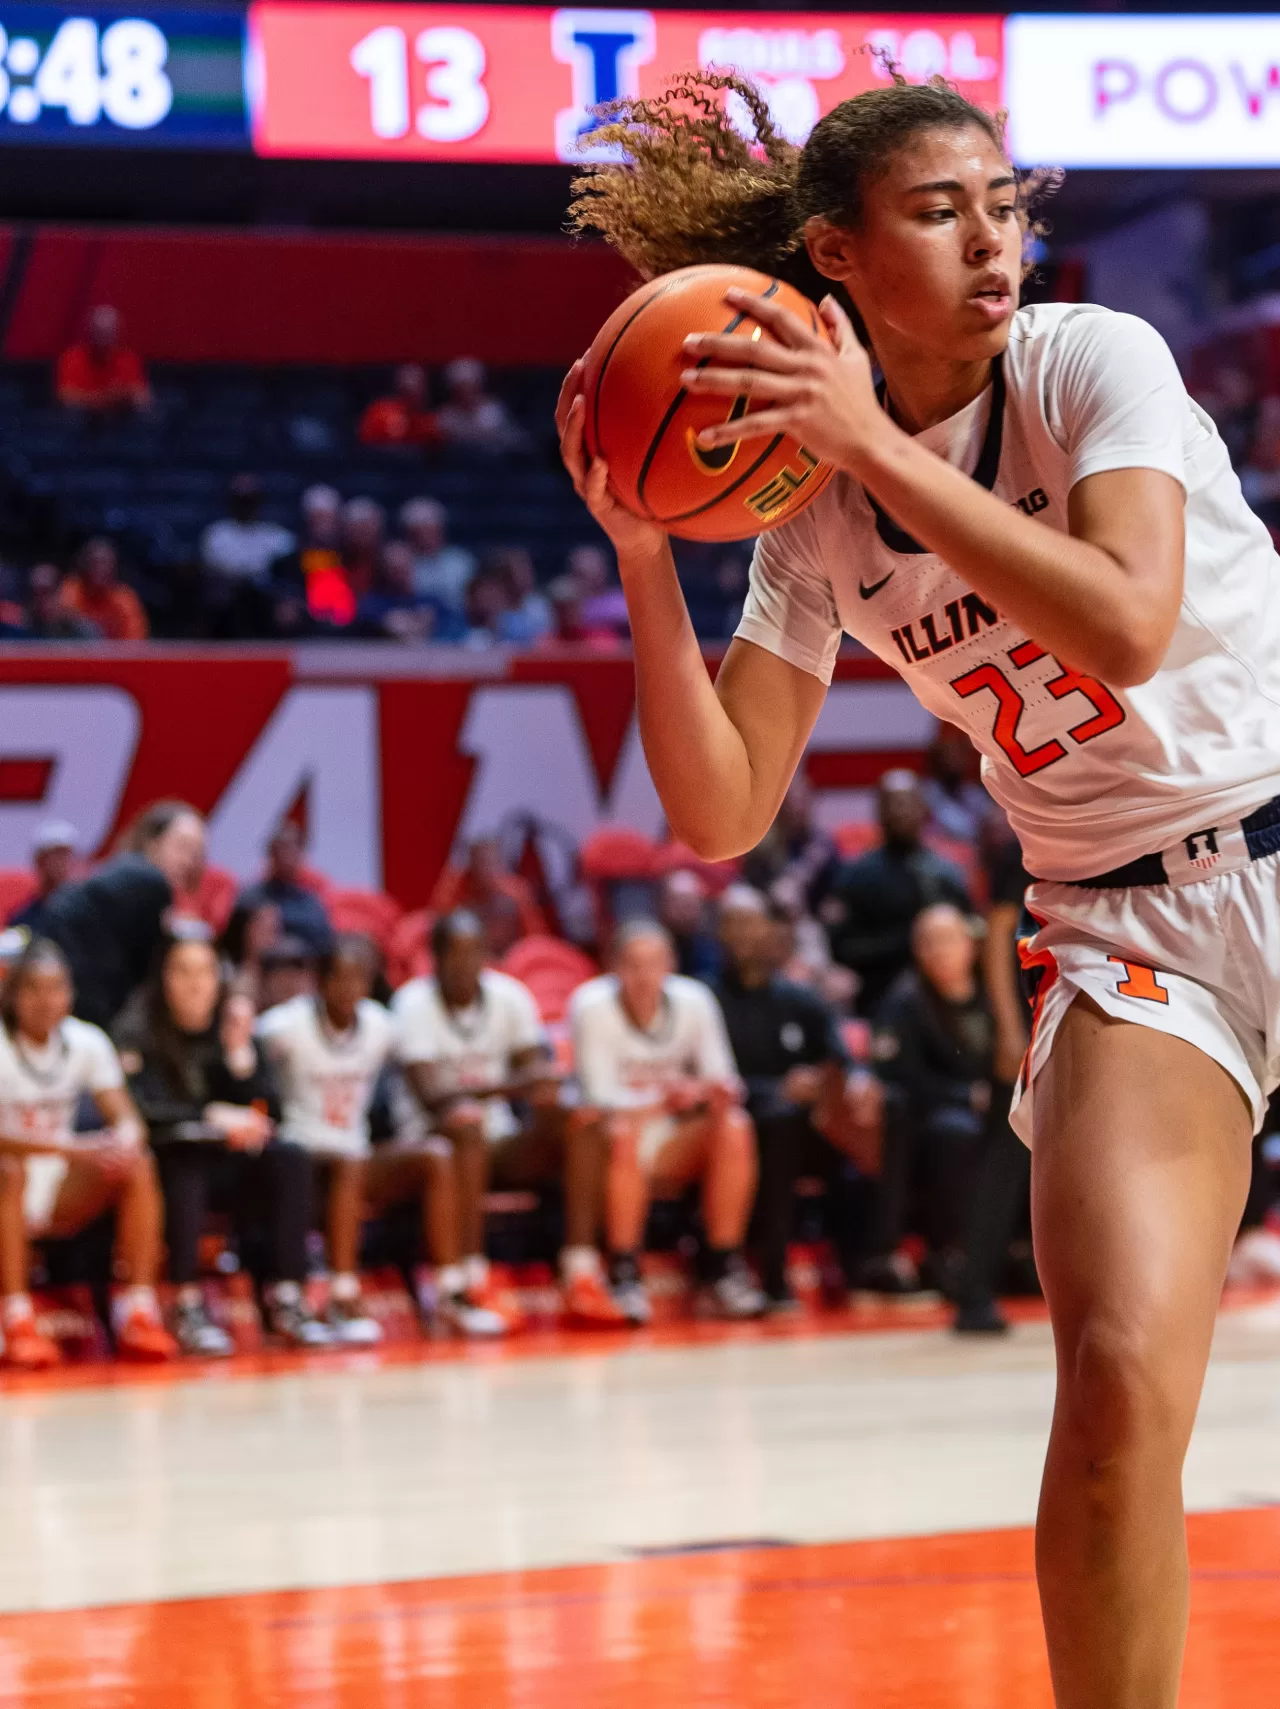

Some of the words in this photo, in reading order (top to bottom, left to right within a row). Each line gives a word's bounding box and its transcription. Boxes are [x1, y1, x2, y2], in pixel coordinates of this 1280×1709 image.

[0, 17, 173, 129] :48
[350, 25, 490, 142] 13
[949, 639, 1126, 778] 23
